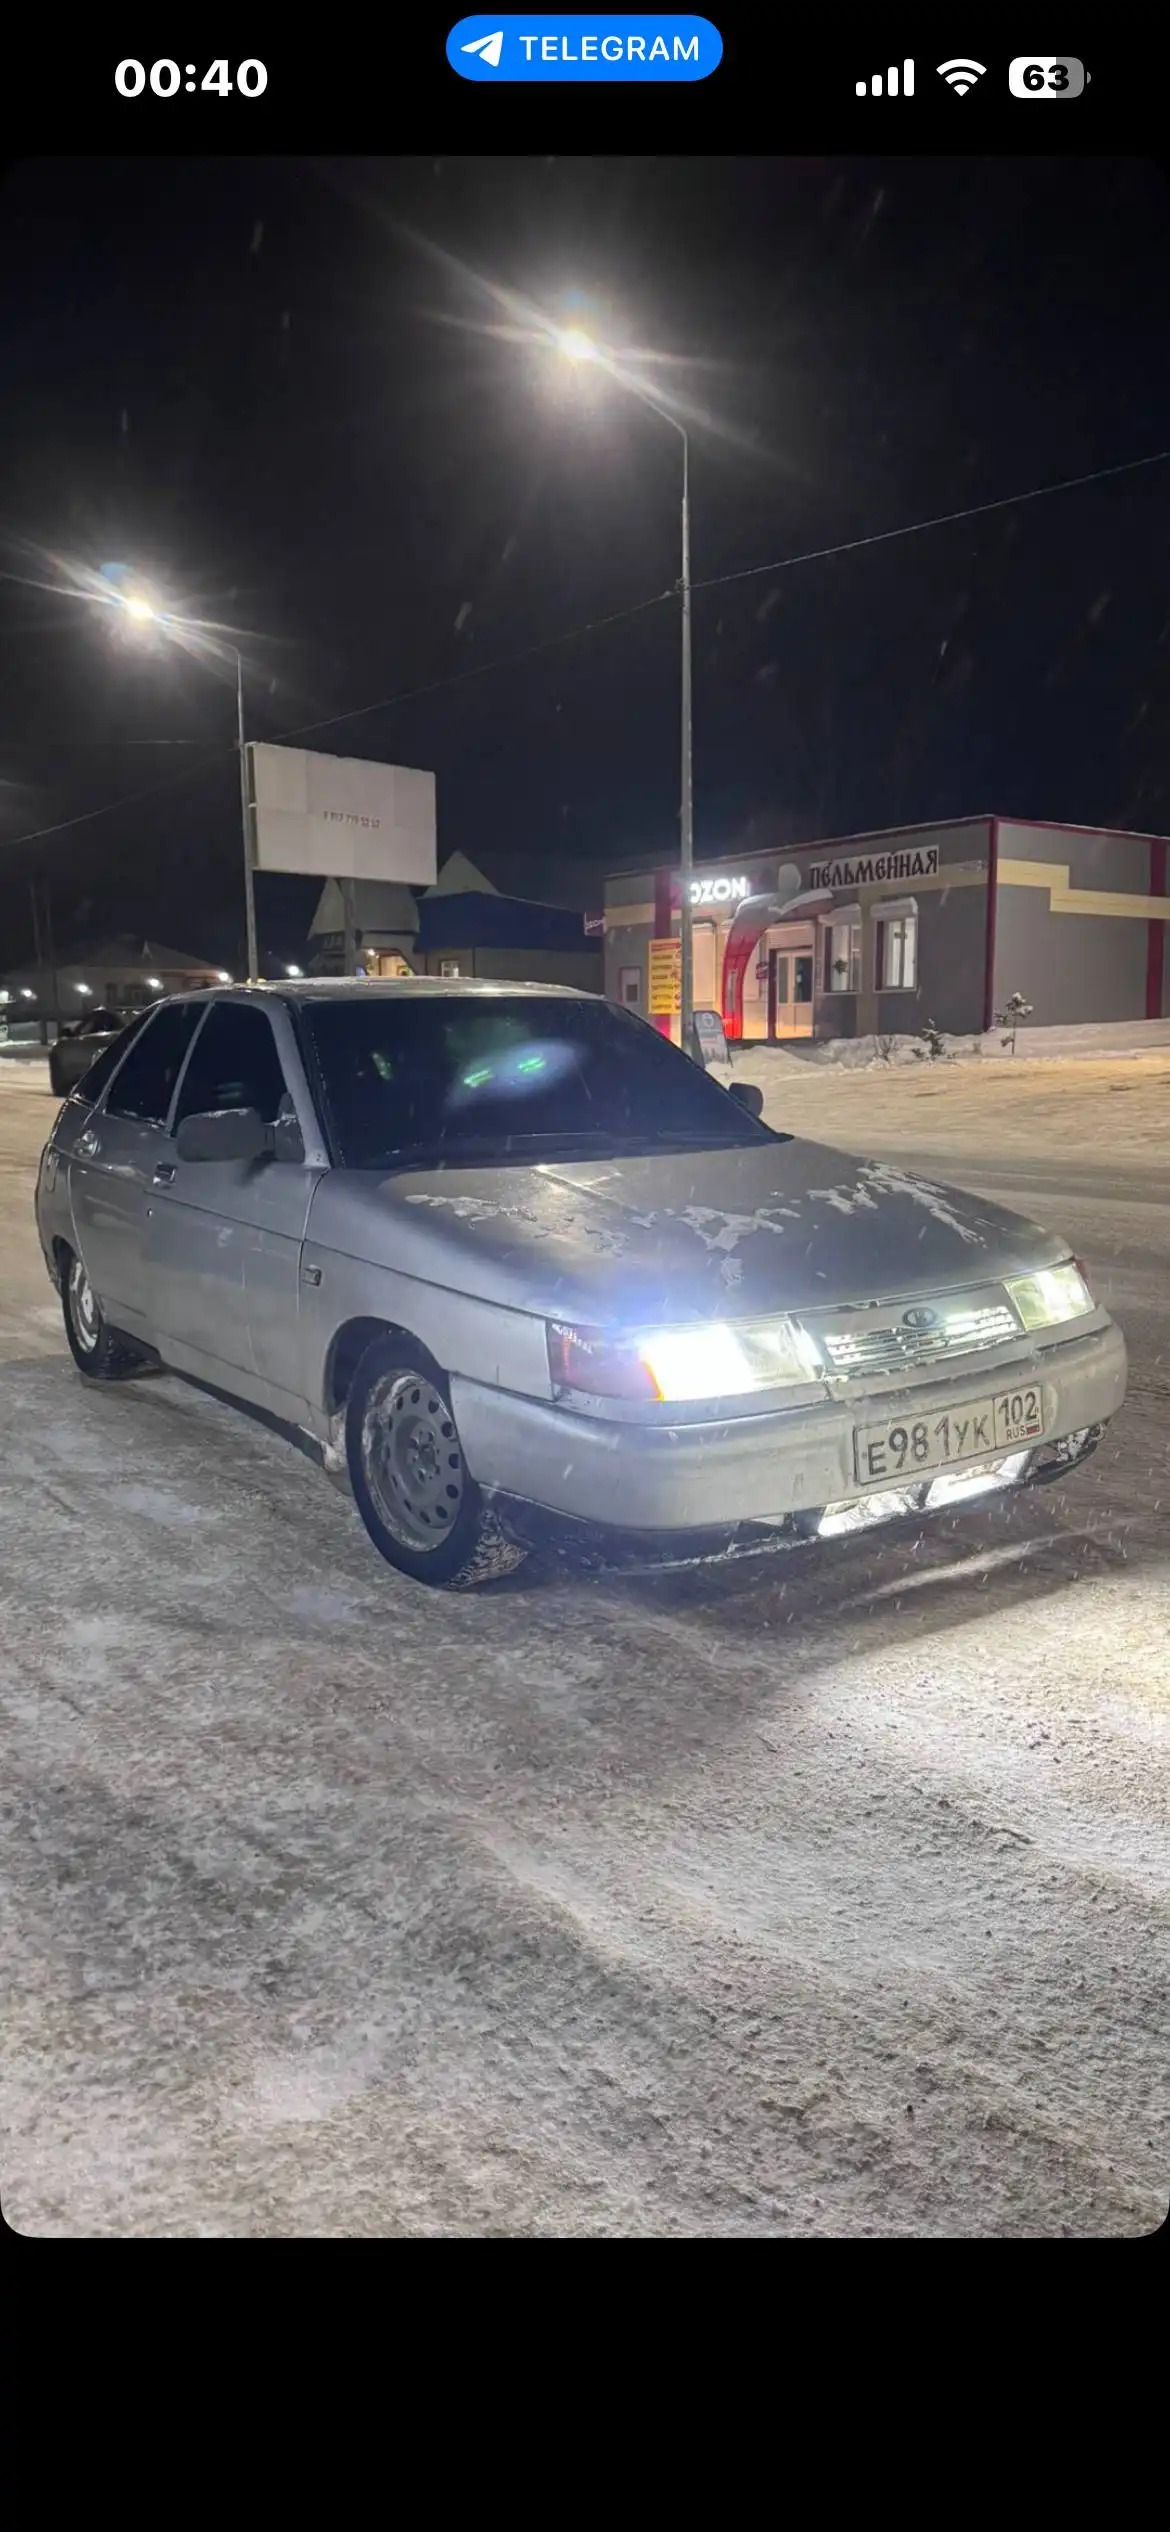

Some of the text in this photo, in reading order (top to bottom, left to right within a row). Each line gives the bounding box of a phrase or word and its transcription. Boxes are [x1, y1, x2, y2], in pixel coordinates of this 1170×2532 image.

[867, 1391, 1038, 1475] Е981УК 102
[1006, 1424, 1026, 1441] RUS
